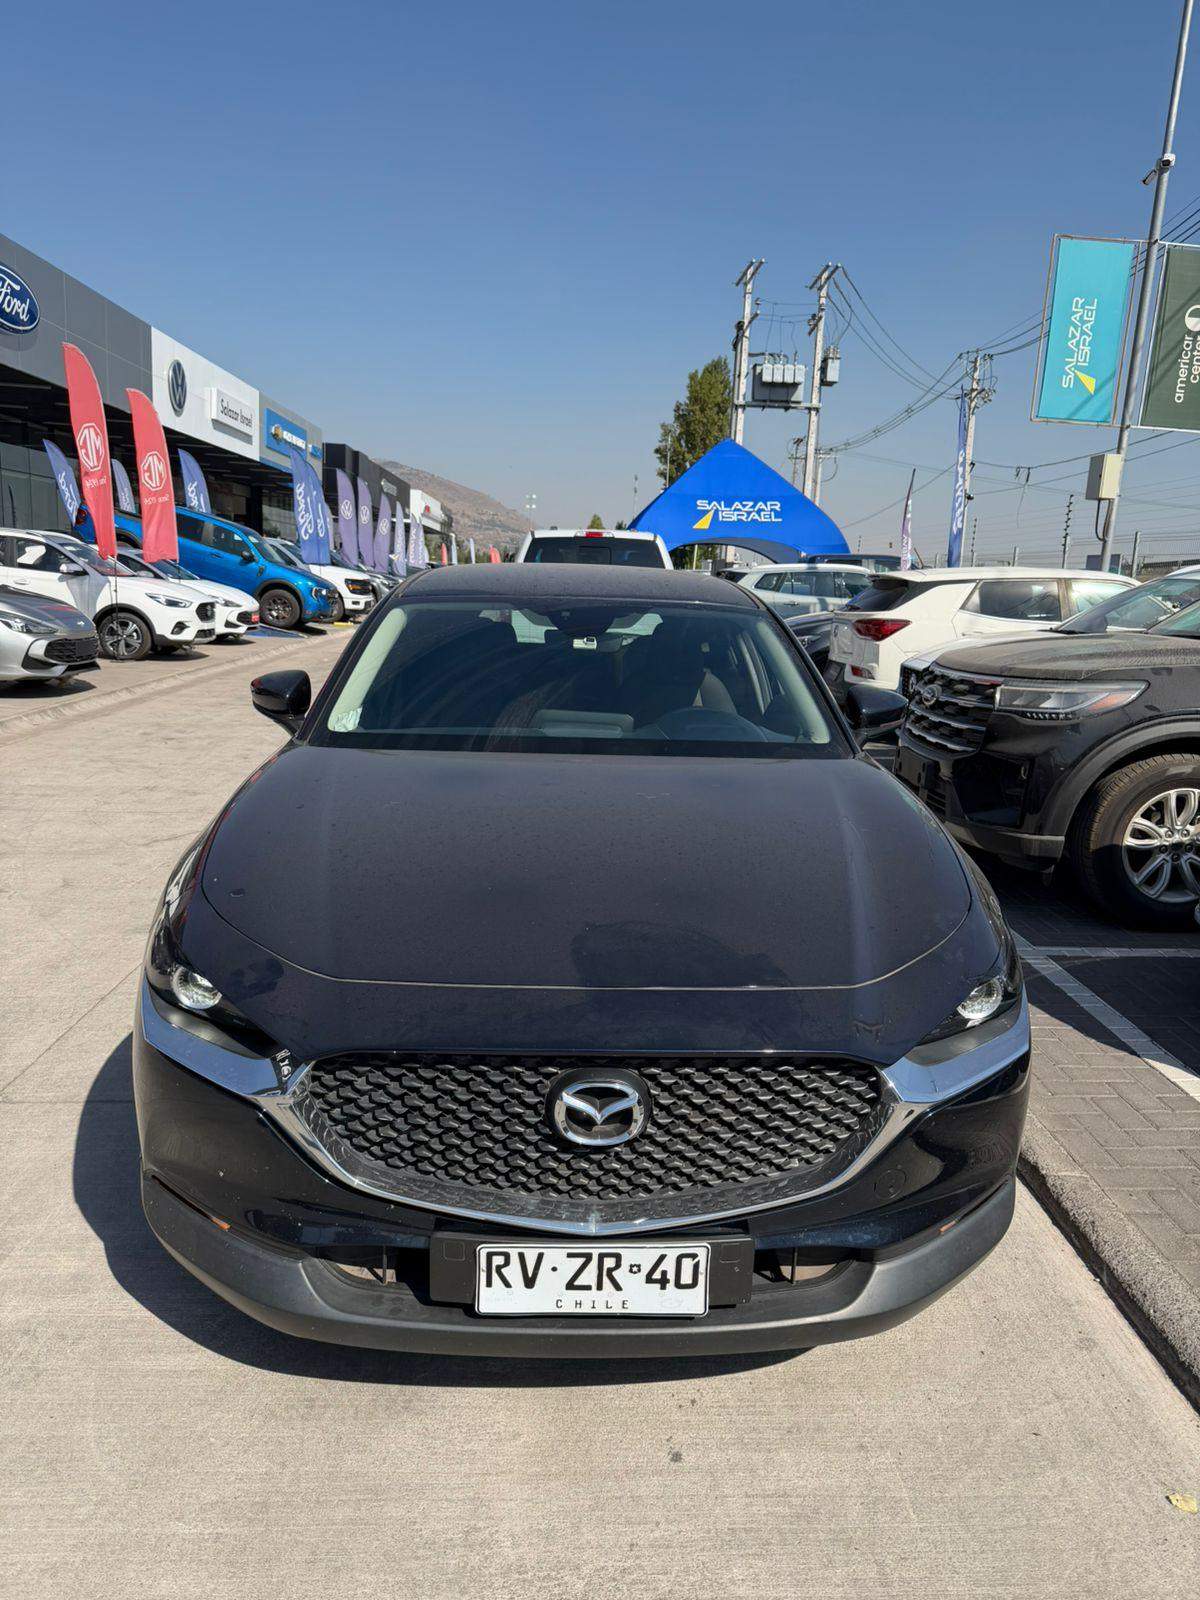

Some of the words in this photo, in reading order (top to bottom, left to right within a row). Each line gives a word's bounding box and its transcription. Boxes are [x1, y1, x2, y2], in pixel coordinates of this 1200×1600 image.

[1062, 297, 1085, 389] SALAZAR
[1077, 298, 1097, 366] ISRAEL
[1175, 334, 1194, 403] americar
[696, 499, 781, 511] SALAZAR
[719, 511, 782, 521] ISRAEL
[555, 1299, 629, 1310] CHILE
